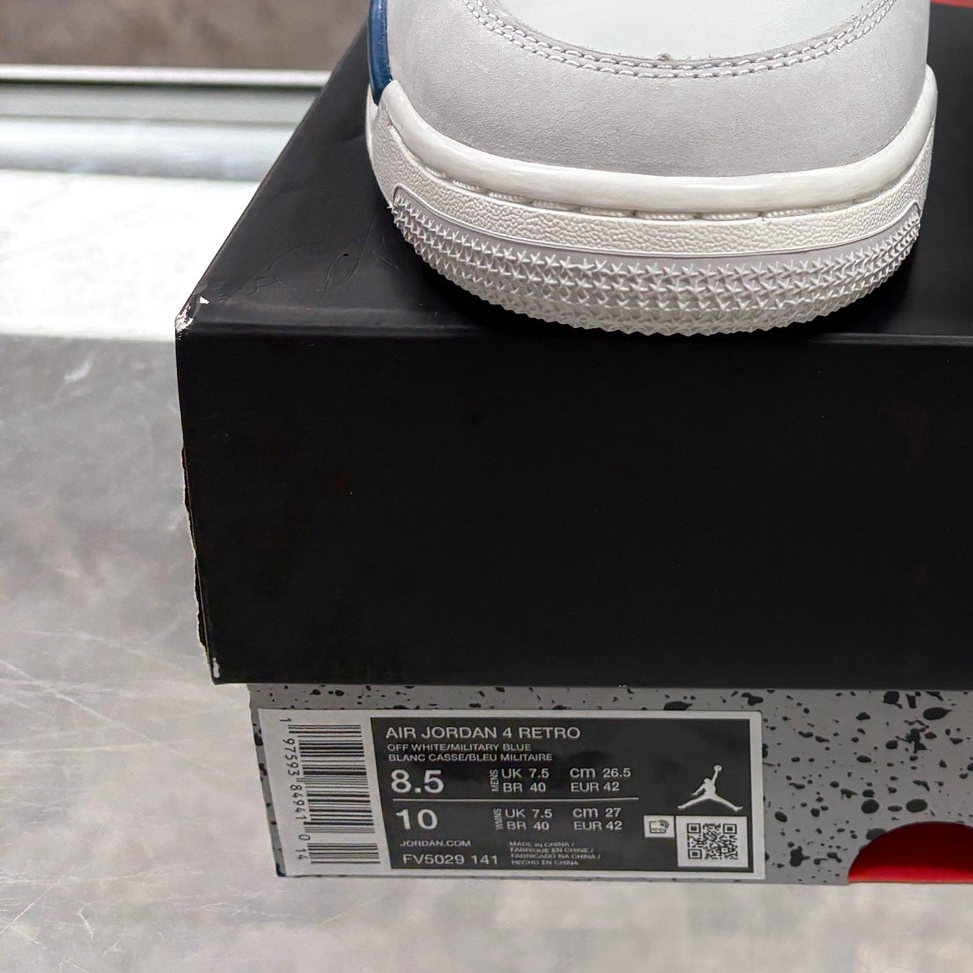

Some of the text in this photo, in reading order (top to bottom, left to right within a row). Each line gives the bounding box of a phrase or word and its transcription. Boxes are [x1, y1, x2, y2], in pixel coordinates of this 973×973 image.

[385, 727, 581, 739] AIR JORDAN 4 RETRO
[387, 743, 532, 751] OFF WHITE/MILITARY BLUE
[283, 738, 300, 776] 97593
[389, 753, 553, 762] BLANC CASSE/BLEU MILITAIRE
[501, 767, 632, 779] UK 7.5 cm 26.5
[390, 769, 445, 794] 8.5
[490, 769, 499, 792] MENS
[503, 781, 620, 793] BR 40 EUR 42
[290, 784, 307, 821] 84941
[395, 808, 439, 830] 10
[504, 807, 622, 819] UK 7.5 cm 27
[506, 820, 623, 831] BR 40 EUR 42
[402, 853, 498, 865] FV5029 141
